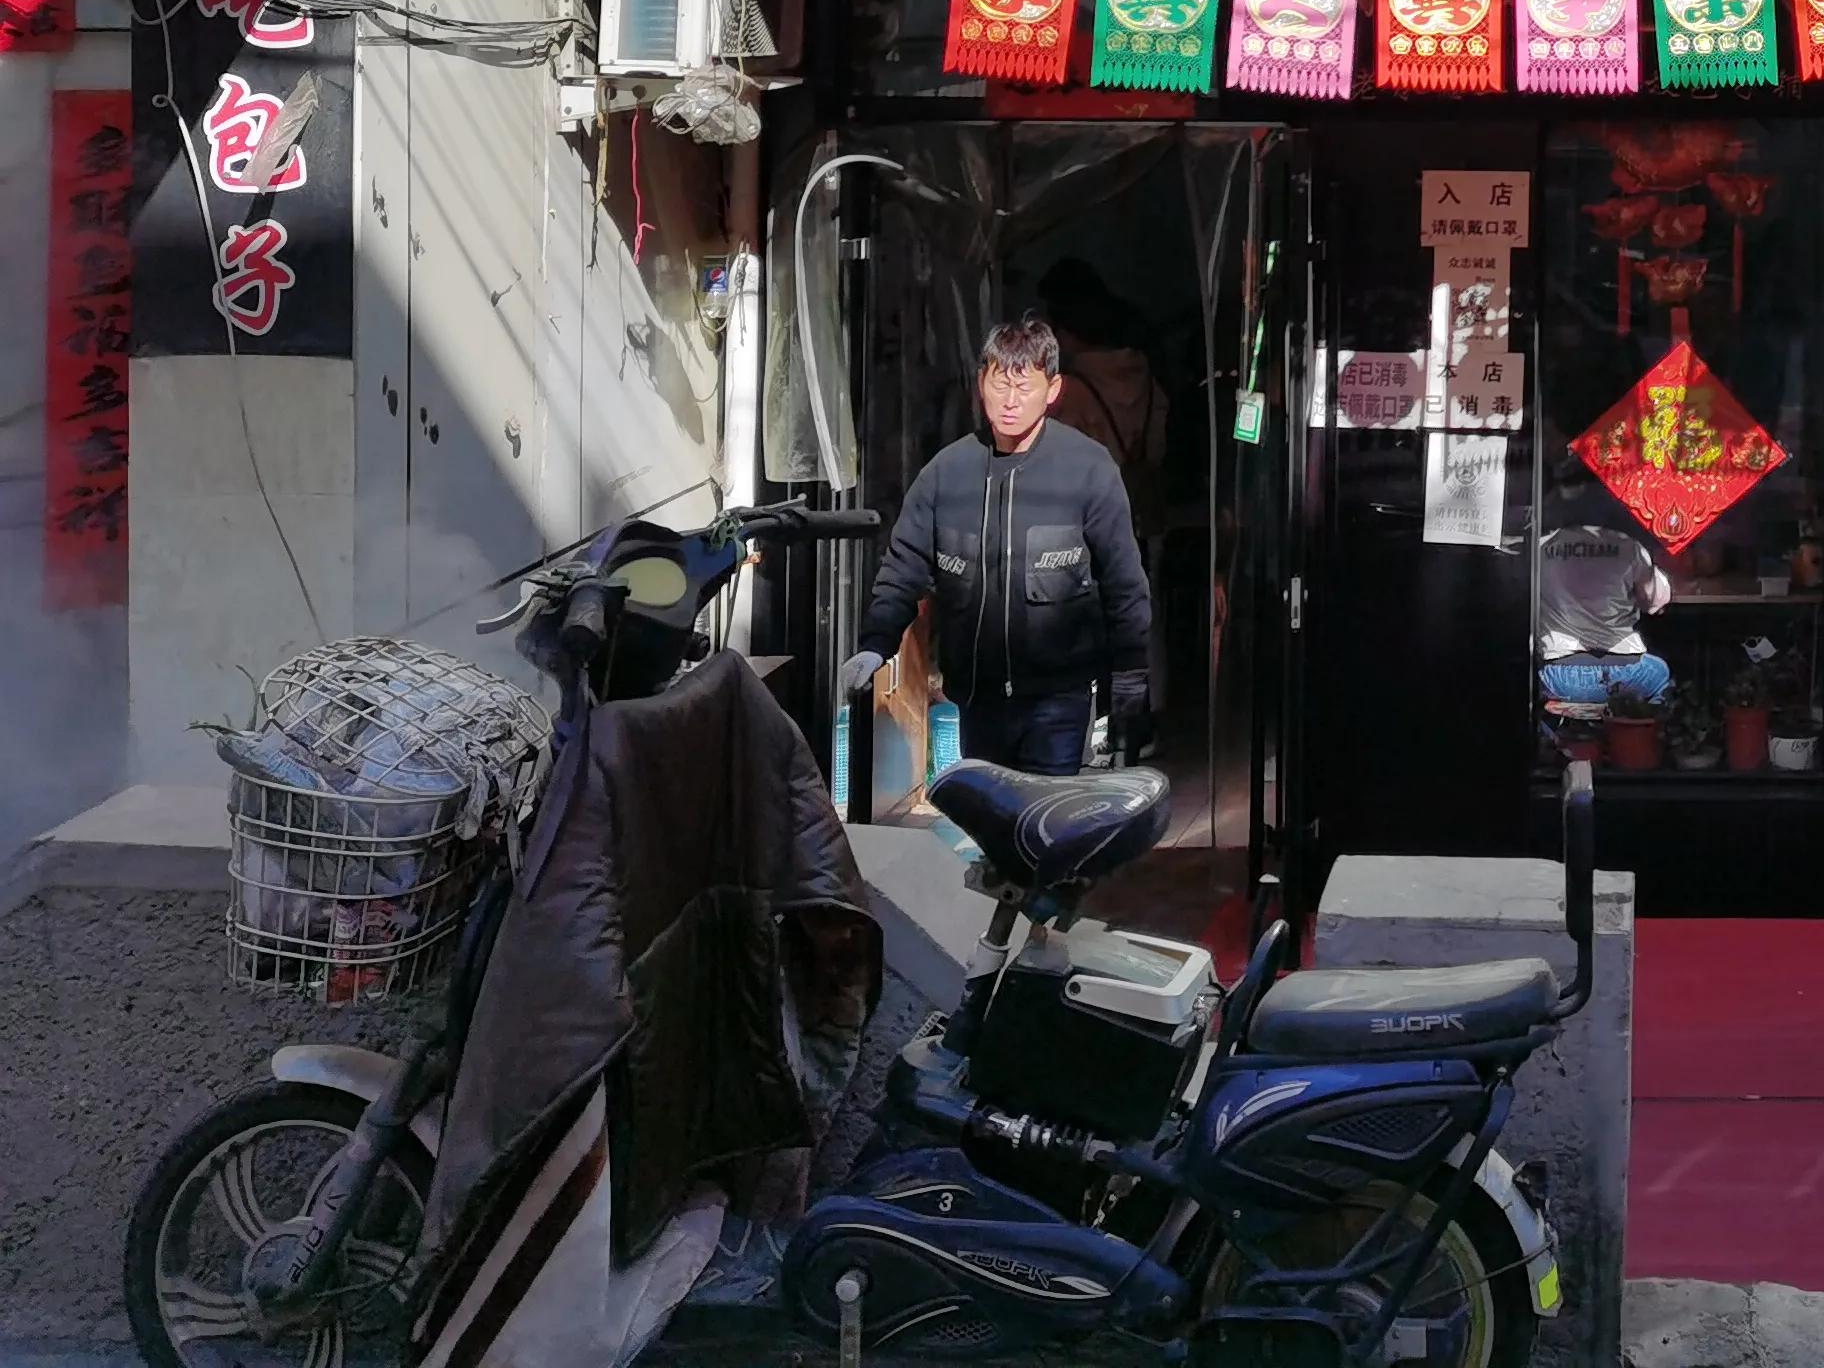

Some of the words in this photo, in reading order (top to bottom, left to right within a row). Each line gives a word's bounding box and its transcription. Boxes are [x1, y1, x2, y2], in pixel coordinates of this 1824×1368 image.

[1430, 218, 1518, 238] 请佩戴口罩
